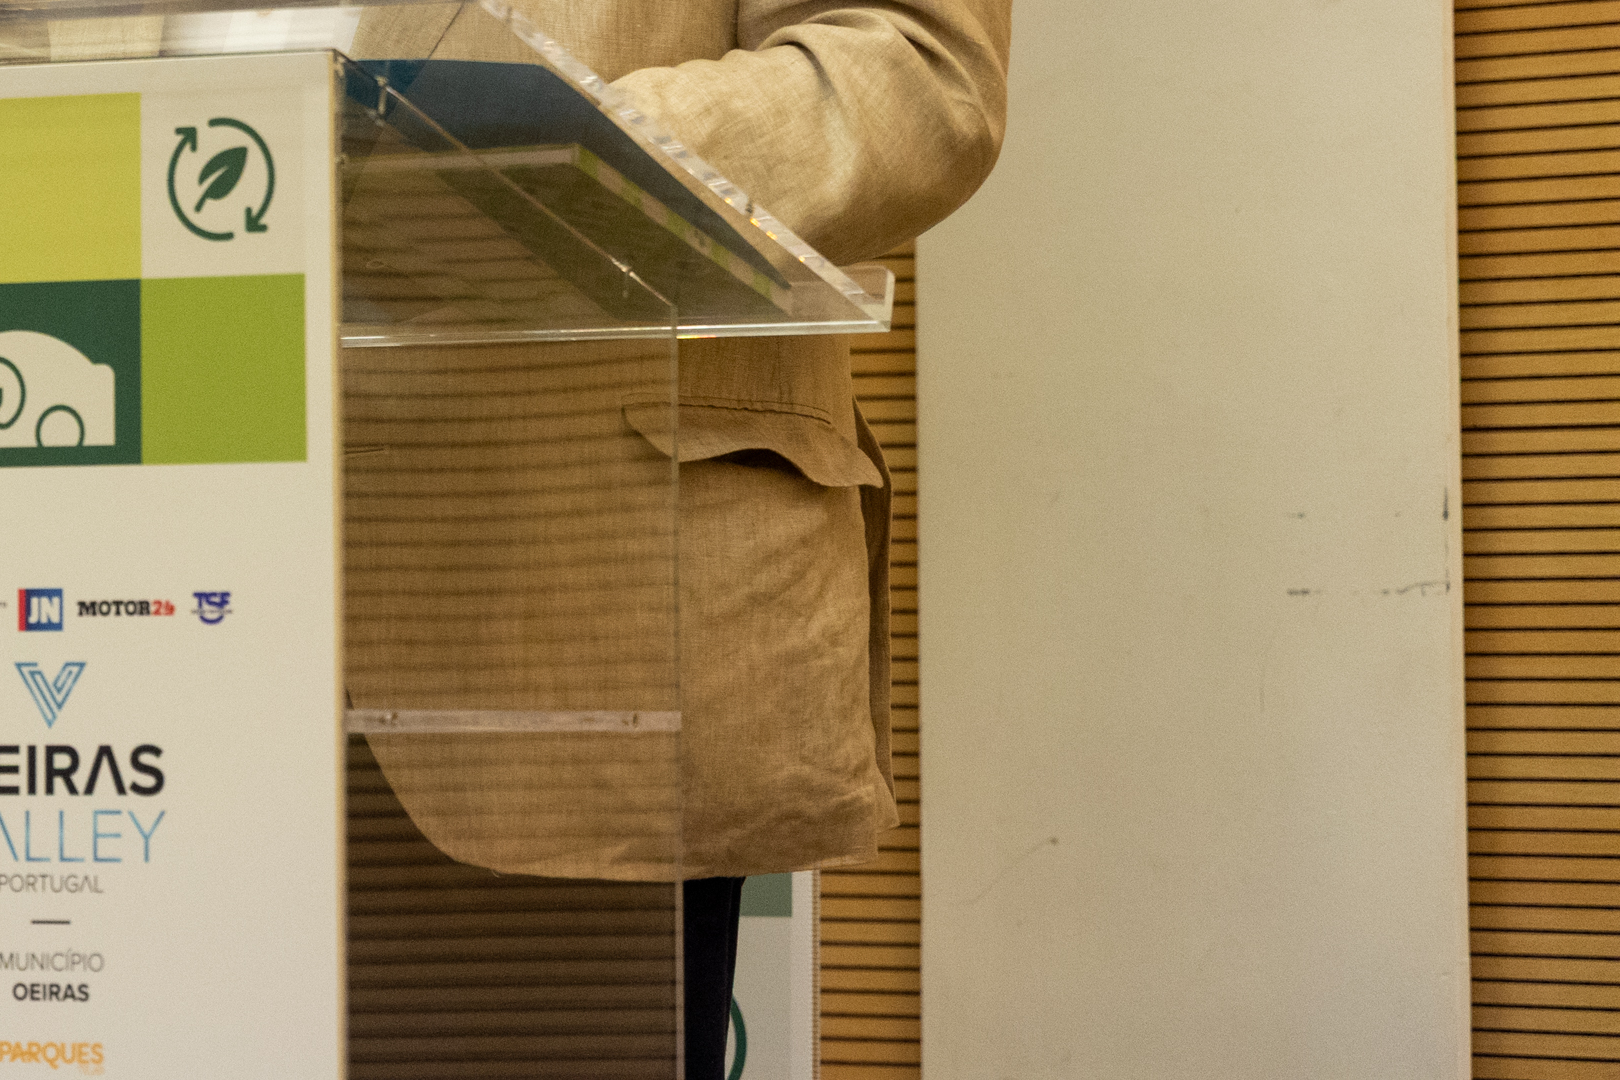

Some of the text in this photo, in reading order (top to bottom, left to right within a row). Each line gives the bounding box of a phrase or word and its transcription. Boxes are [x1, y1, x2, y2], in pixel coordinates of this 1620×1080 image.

[27, 596, 61, 624] JN
[192, 591, 232, 610] TSF
[12, 982, 90, 1002] OEIRAS
